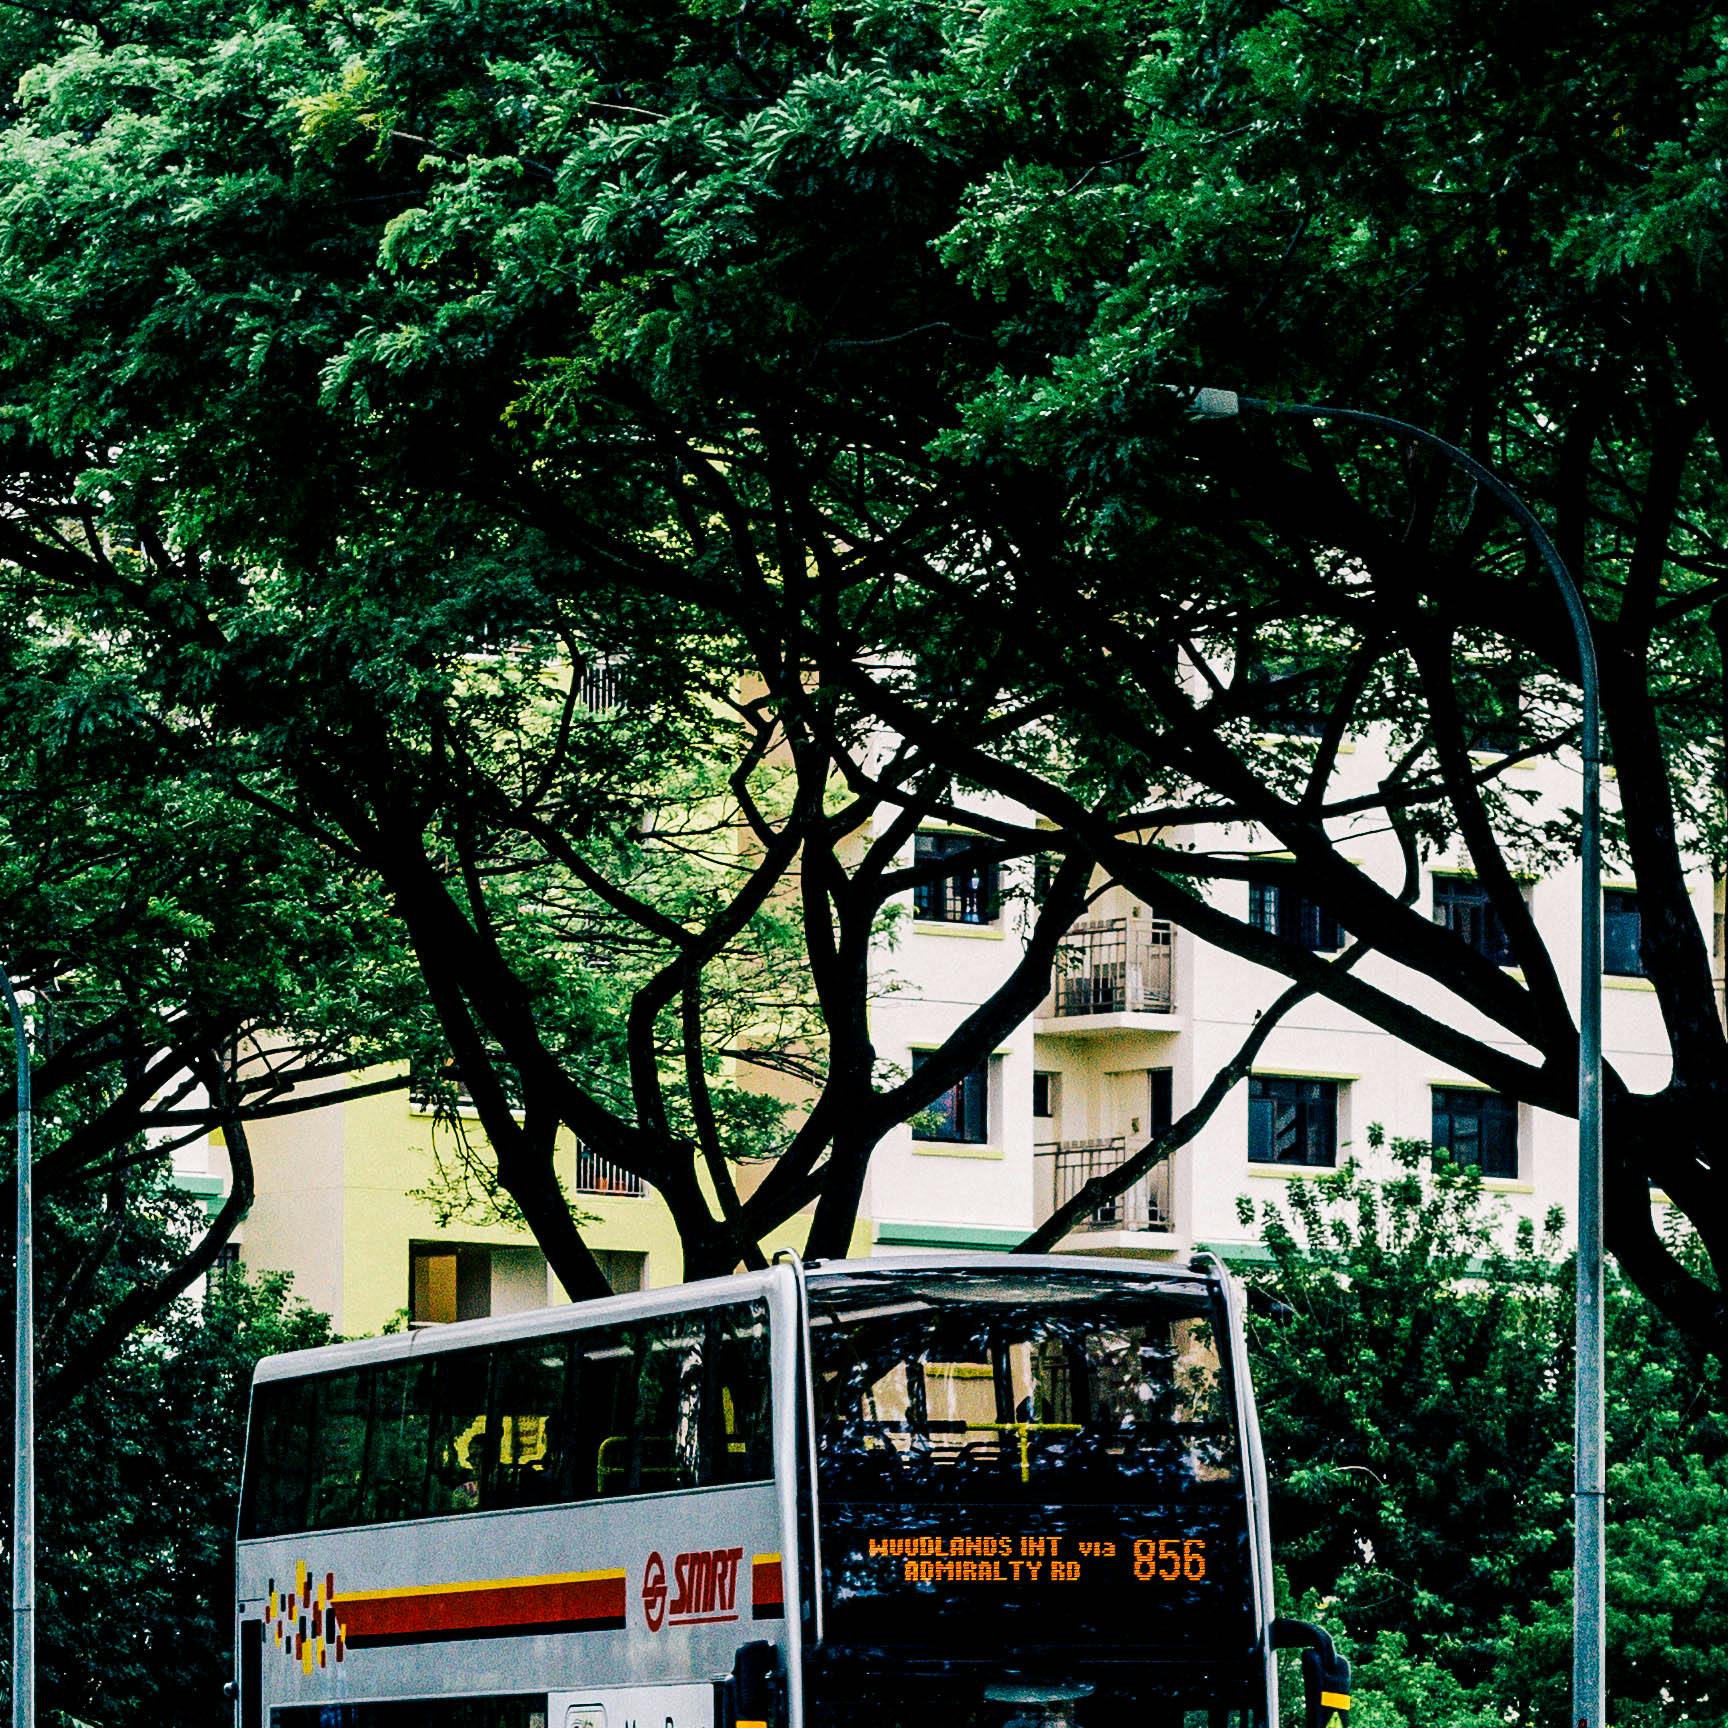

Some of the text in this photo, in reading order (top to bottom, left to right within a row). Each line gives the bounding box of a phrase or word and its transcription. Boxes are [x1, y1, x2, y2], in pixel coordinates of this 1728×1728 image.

[1021, 1537, 1063, 1557] INT
[1133, 1539, 1206, 1581] 856
[669, 1547, 743, 1614] SMRT
[904, 1561, 1081, 1581] ADMIRALTY RD
